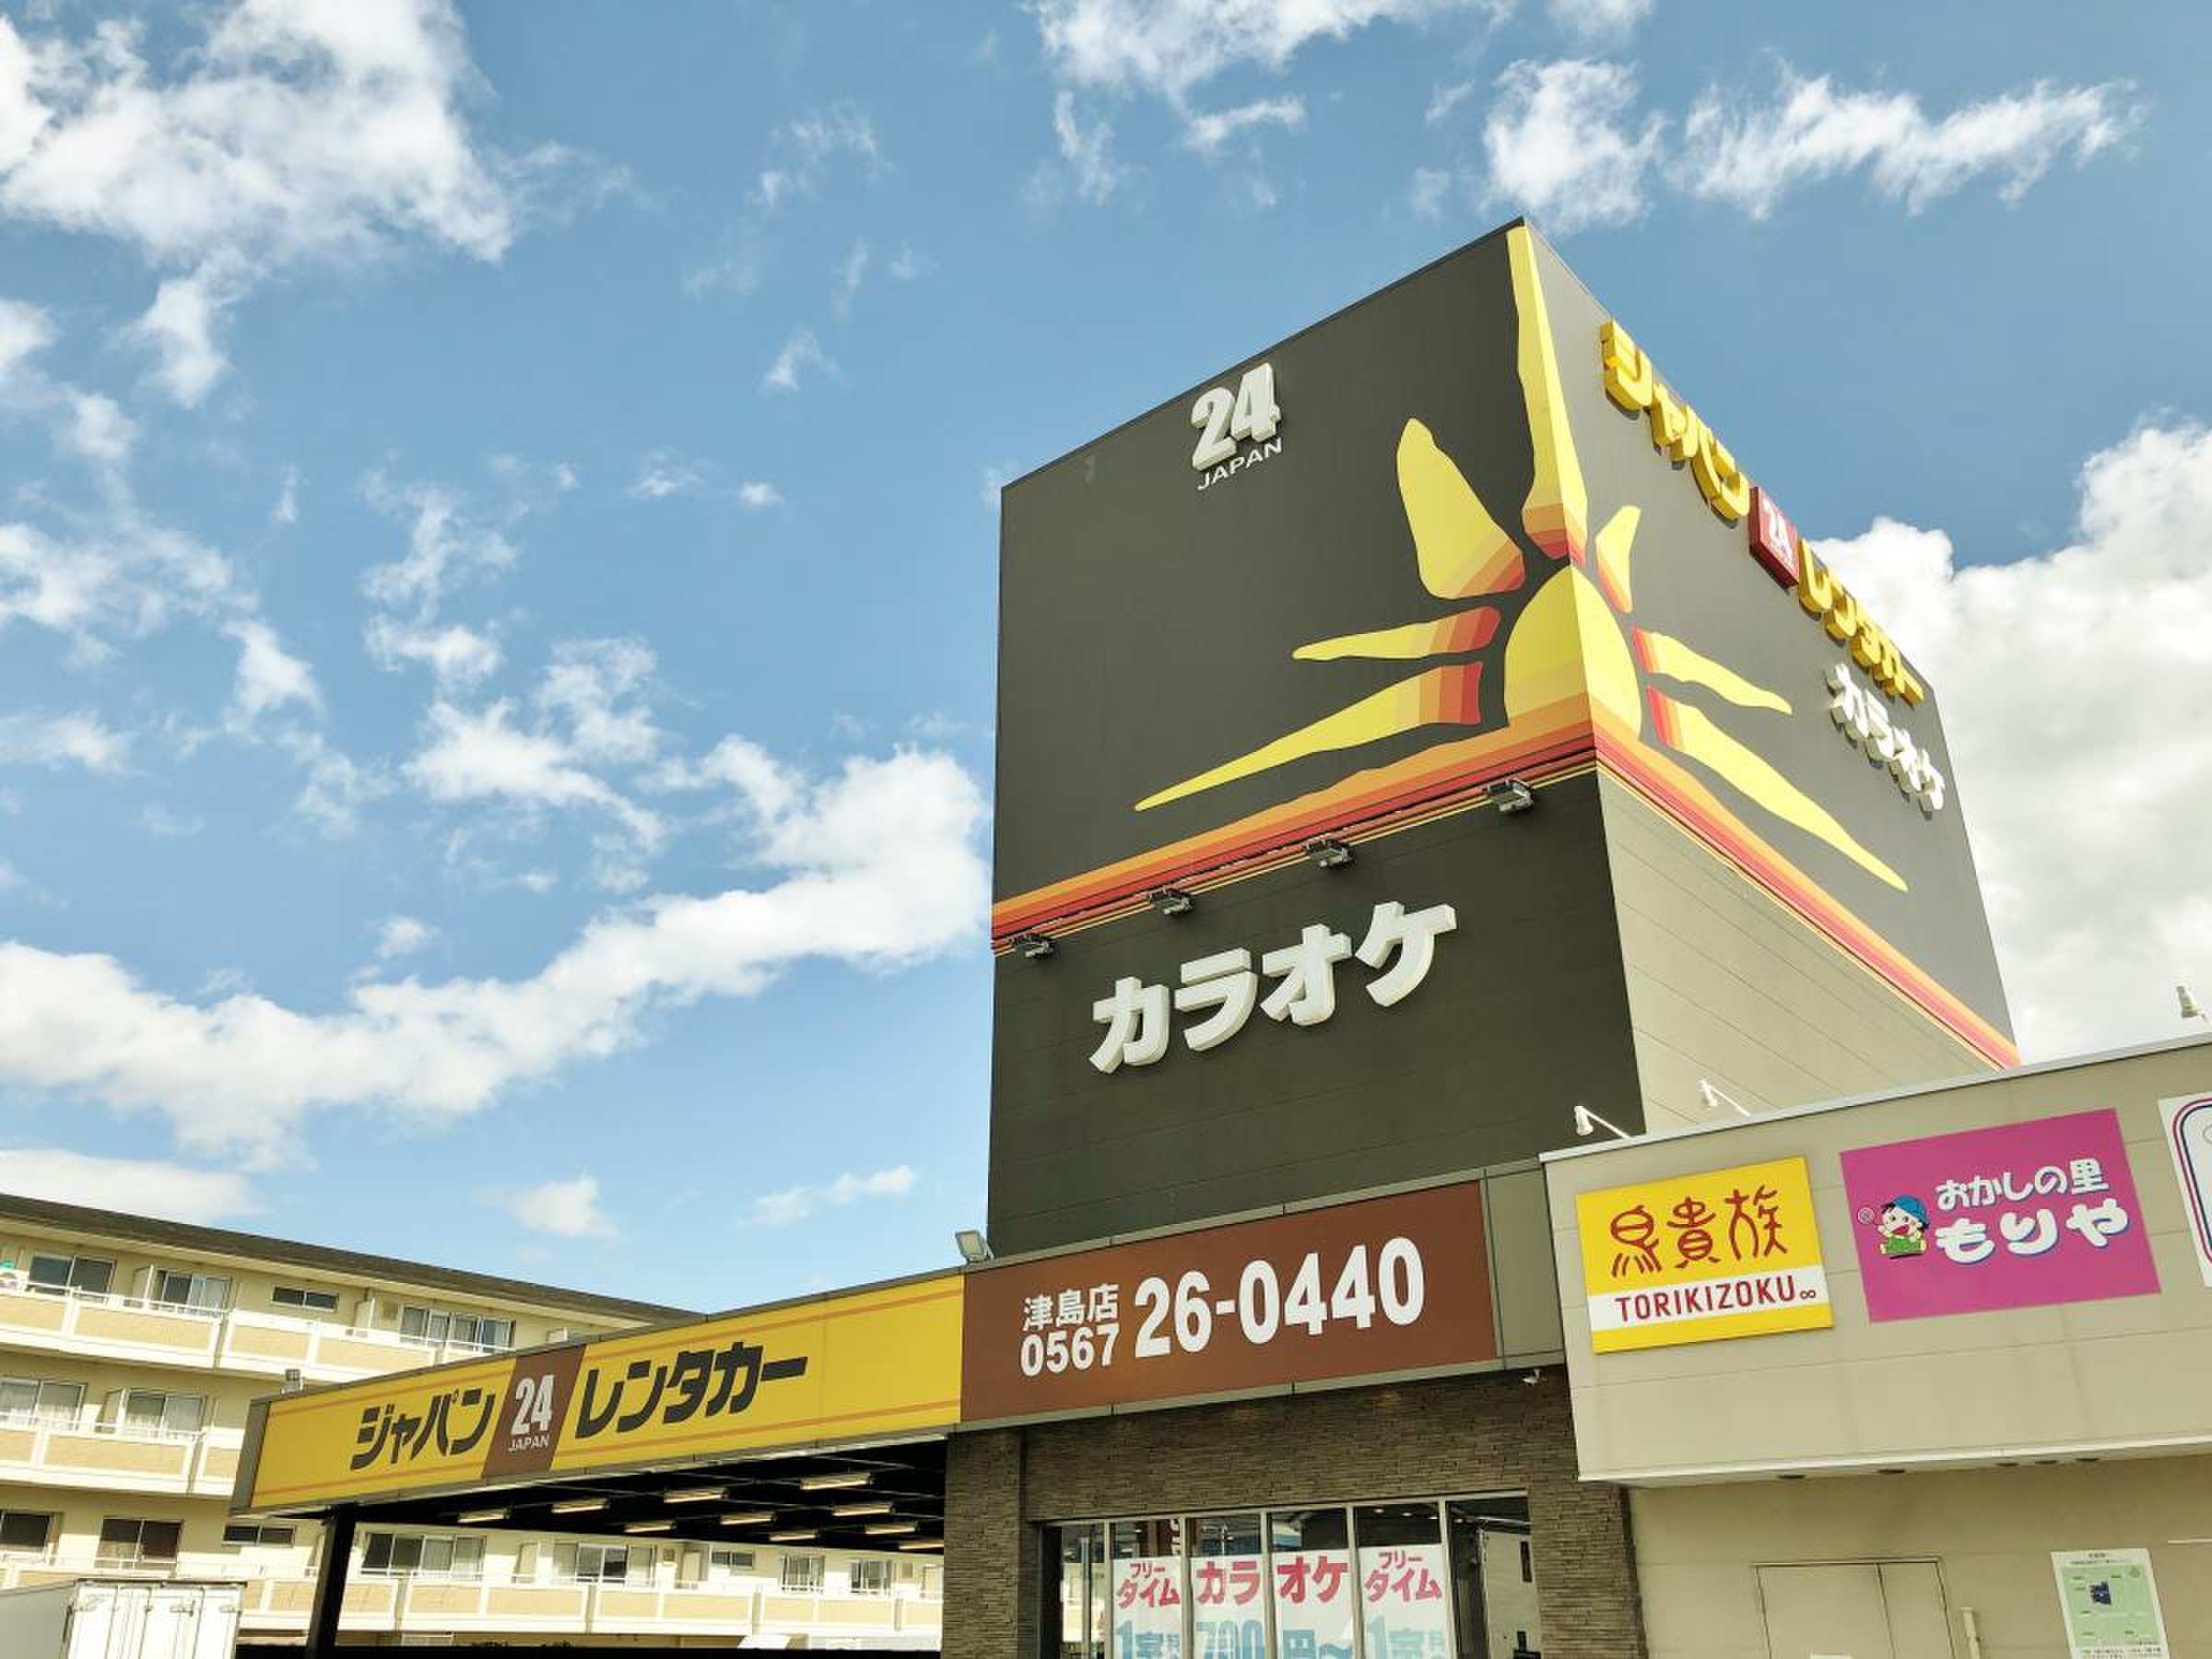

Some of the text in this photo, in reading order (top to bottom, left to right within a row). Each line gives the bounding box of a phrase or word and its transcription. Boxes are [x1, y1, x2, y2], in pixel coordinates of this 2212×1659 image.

[1191, 362, 1281, 471] 24
[1197, 437, 1282, 490] JAPAN
[1827, 663, 1946, 810] カラオケ
[1089, 900, 1457, 1075] カラオケ
[1935, 1158, 2110, 1211] おかしの里
[1610, 1184, 1788, 1277] 鳥貴族
[1935, 1197, 2129, 1265] もりや
[1022, 1283, 1119, 1332] 津島店
[1134, 1236, 1425, 1358] 26-0440
[1615, 1275, 1795, 1323] TORIKIZOKU
[1020, 1324, 1120, 1377] 0567
[349, 1340, 808, 1471] ジャパン 24 レンタカー
[507, 1433, 550, 1453] JAPAN
[1130, 1561, 1166, 1579] フリー
[1364, 1567, 1443, 1603] タイム
[1378, 1550, 1424, 1570] フリー
[1115, 1577, 1181, 1609] タイム
